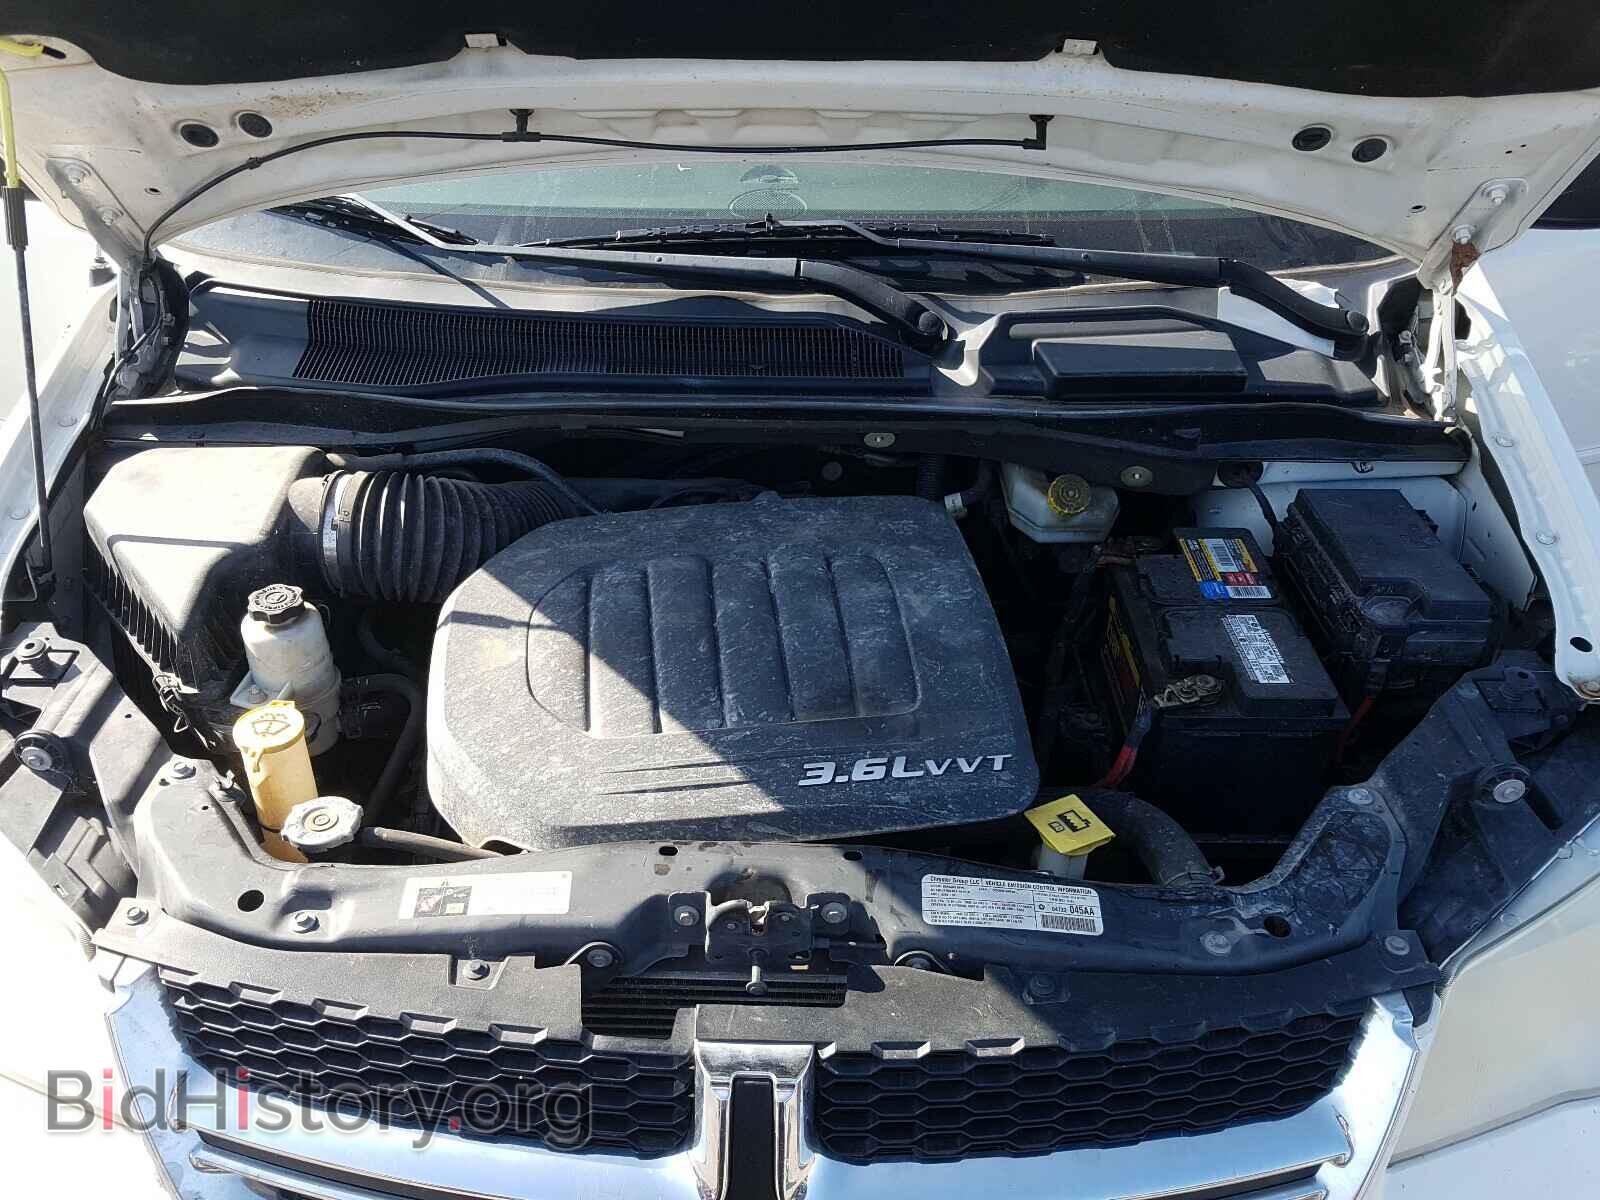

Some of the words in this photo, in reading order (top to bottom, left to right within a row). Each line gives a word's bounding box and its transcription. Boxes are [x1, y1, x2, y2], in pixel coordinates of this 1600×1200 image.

[952, 876, 968, 885] Group
[1007, 881, 1032, 889] EMISSION
[1032, 884, 1057, 892] CONTROL
[1057, 886, 1092, 895] INFORMATION
[1069, 905, 1095, 916] 045AA
